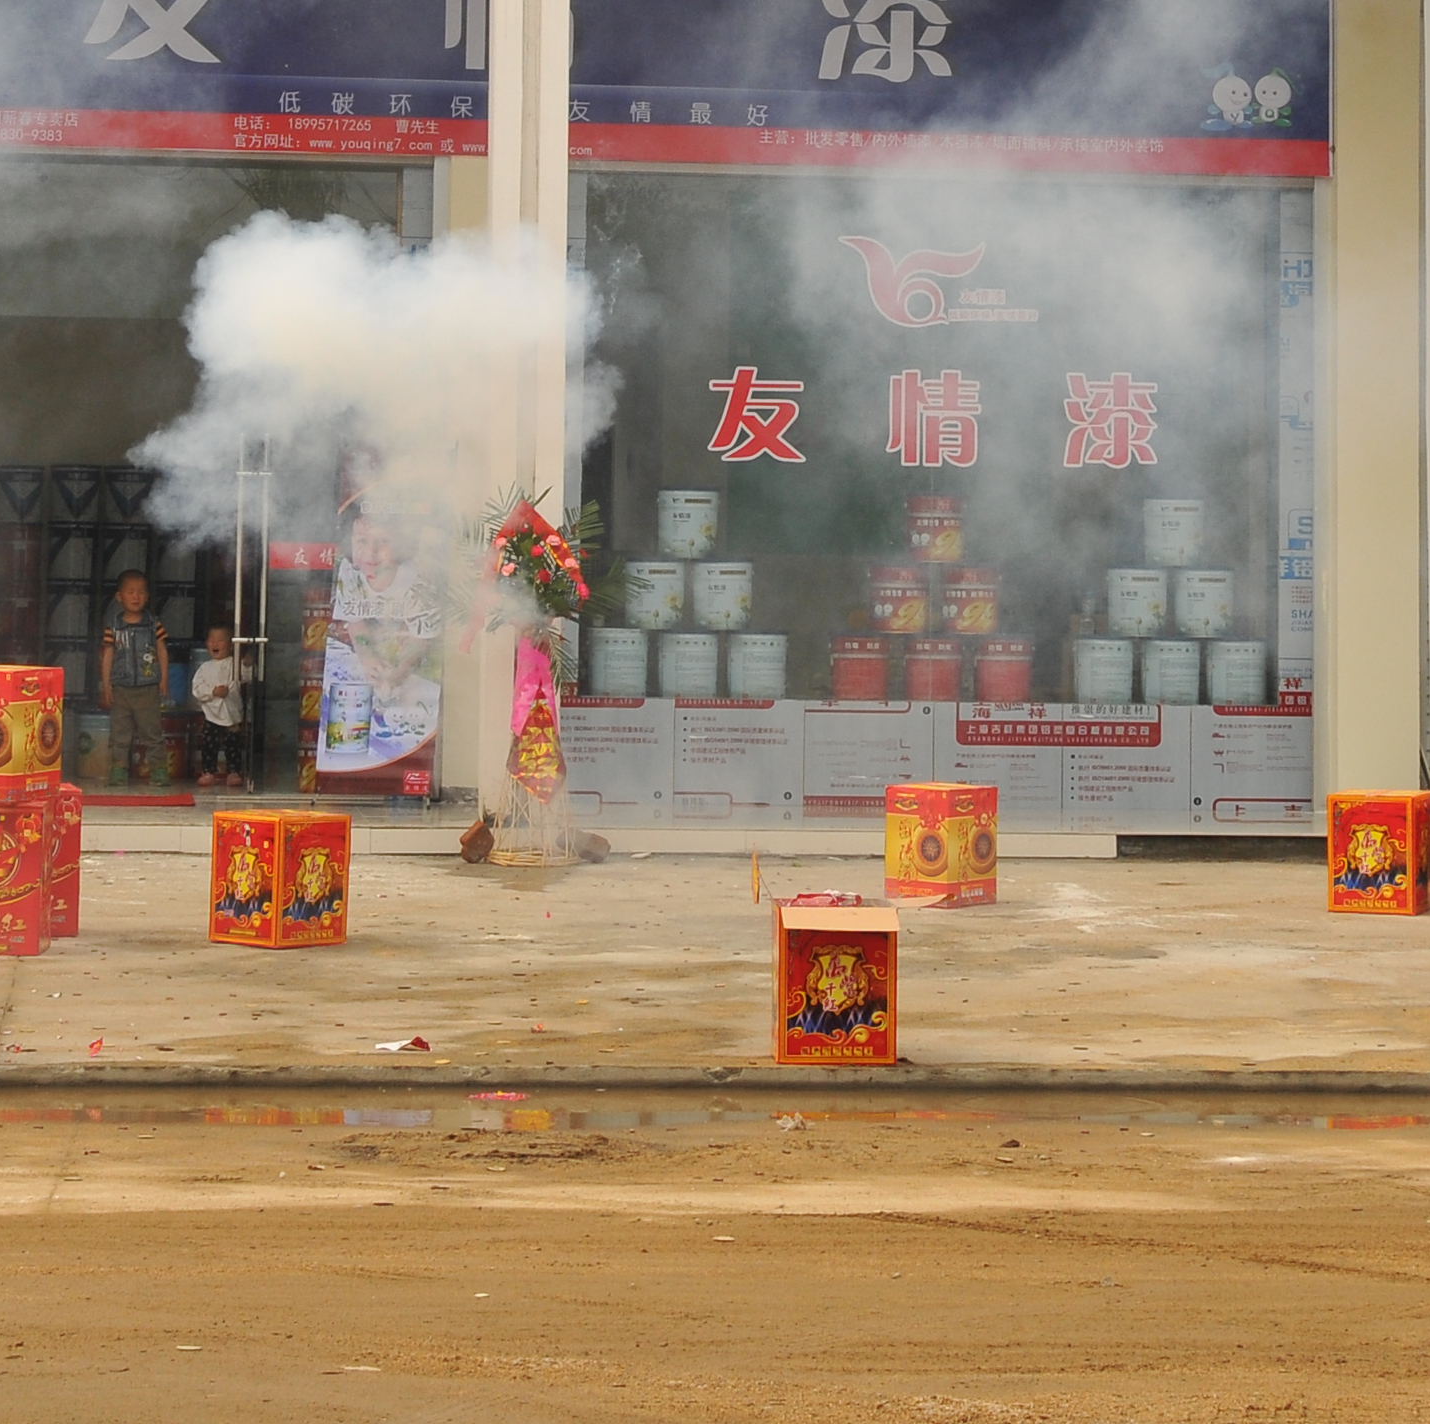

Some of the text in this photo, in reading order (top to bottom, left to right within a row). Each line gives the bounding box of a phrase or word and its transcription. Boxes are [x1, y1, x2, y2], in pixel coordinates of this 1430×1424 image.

[279, 91, 770, 127] 低碳环保 友情最好
[288, 117, 372, 132] 18995717265
[396, 119, 440, 134] 曹先生
[707, 366, 1159, 469] 友情漆
